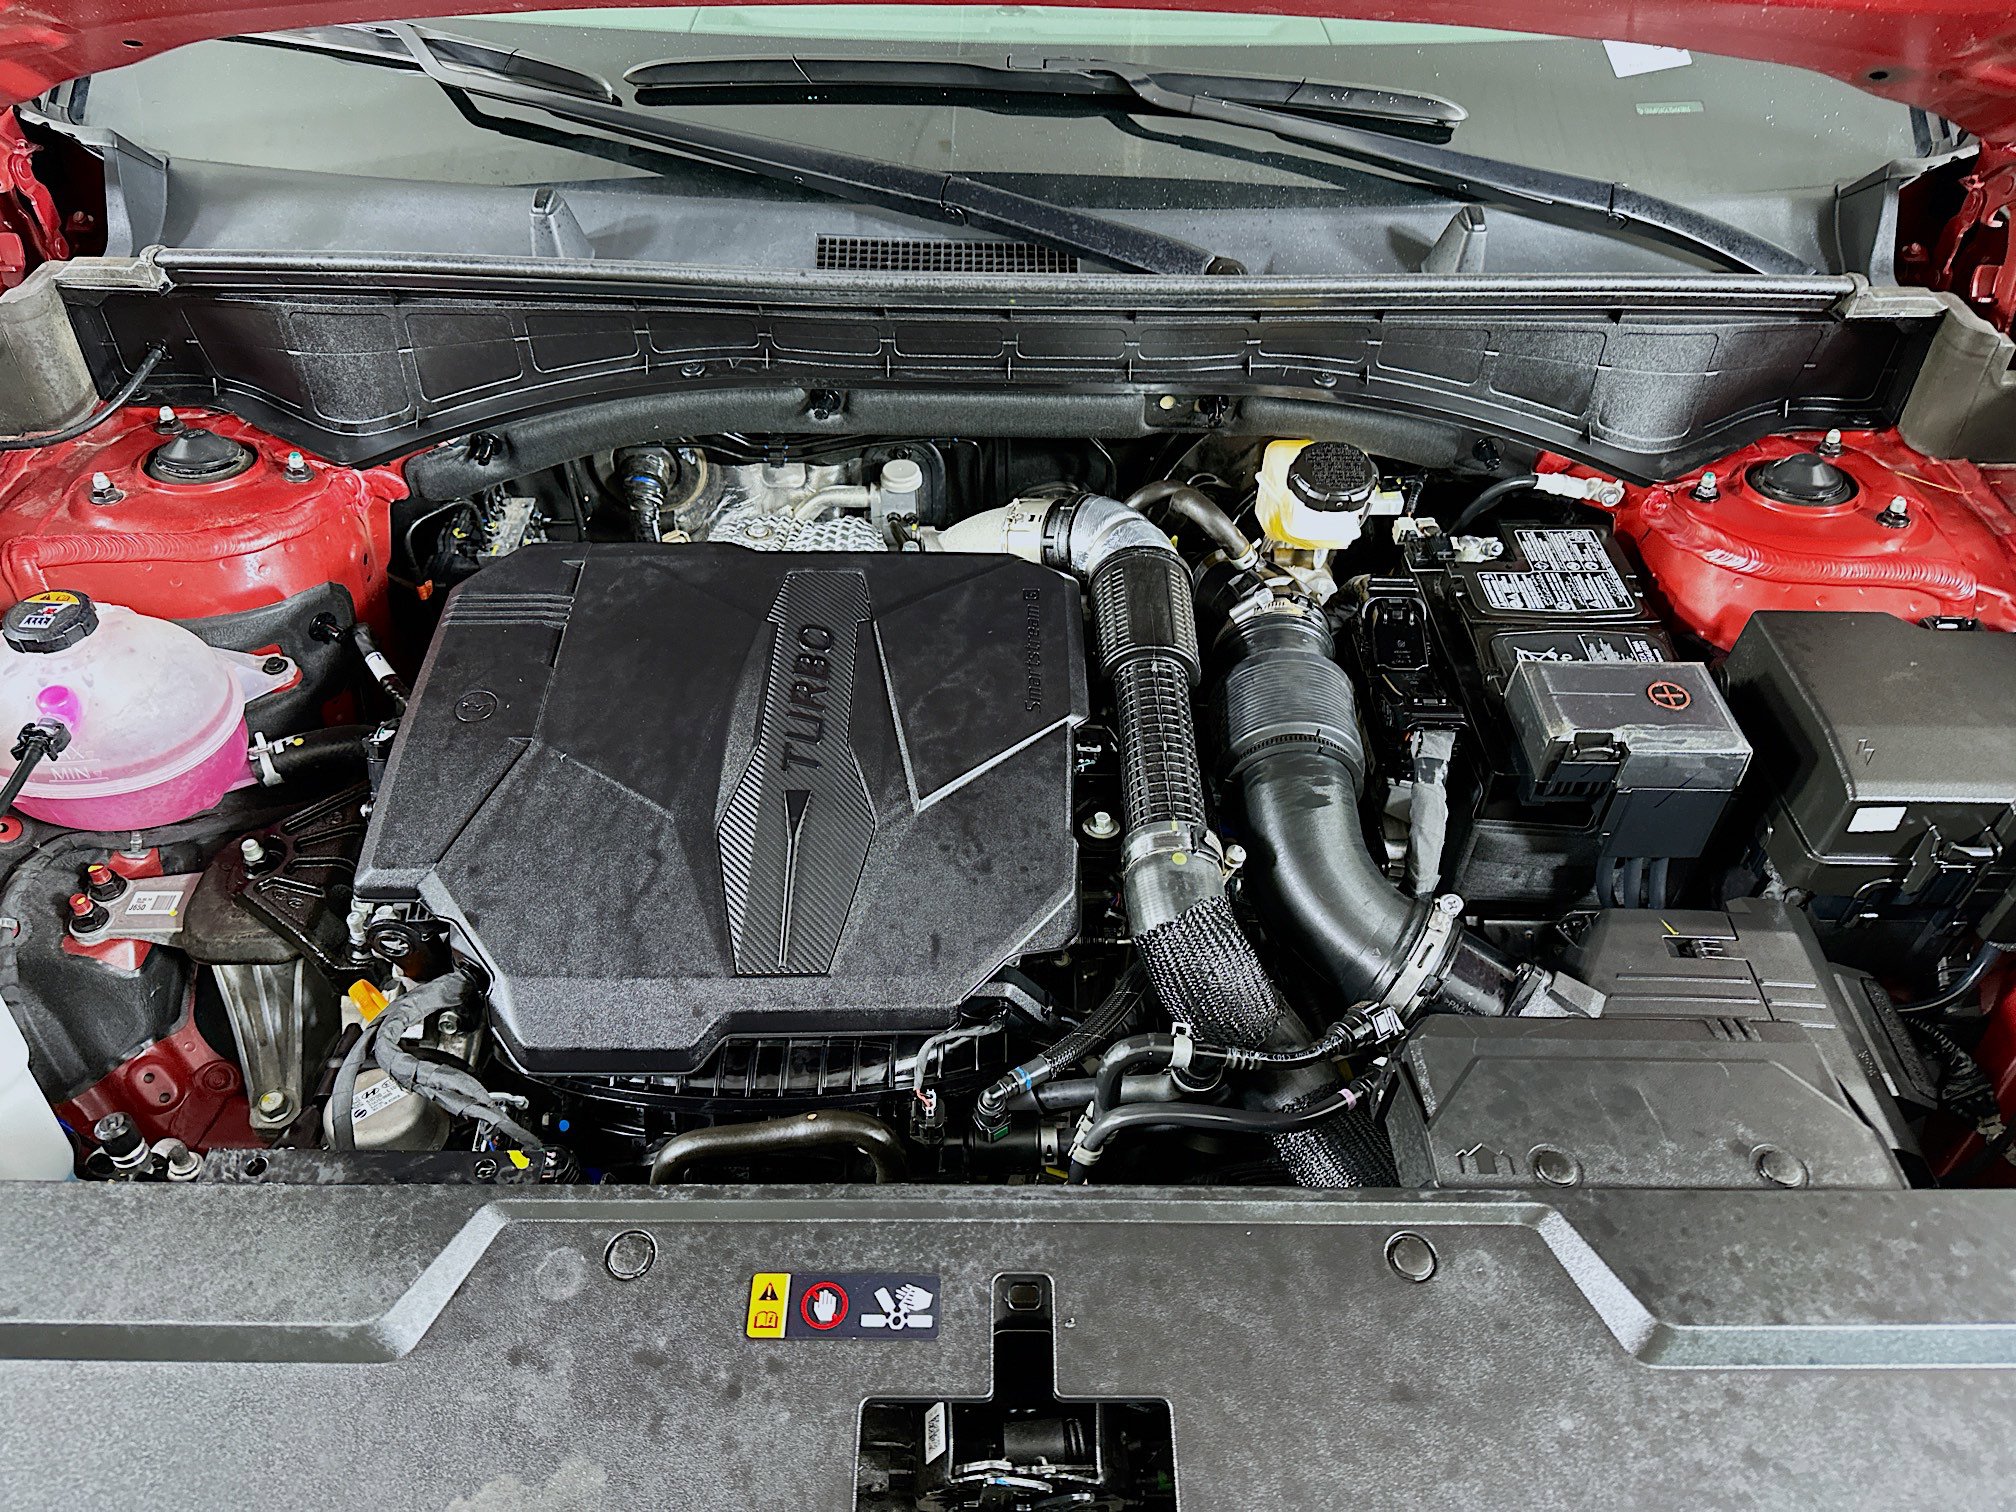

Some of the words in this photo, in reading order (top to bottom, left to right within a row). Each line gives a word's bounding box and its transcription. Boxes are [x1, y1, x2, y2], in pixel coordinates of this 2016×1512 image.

[782, 624, 833, 772] TURBO
[1024, 604, 1041, 713] Smartstream
[51, 766, 90, 780] MIN
